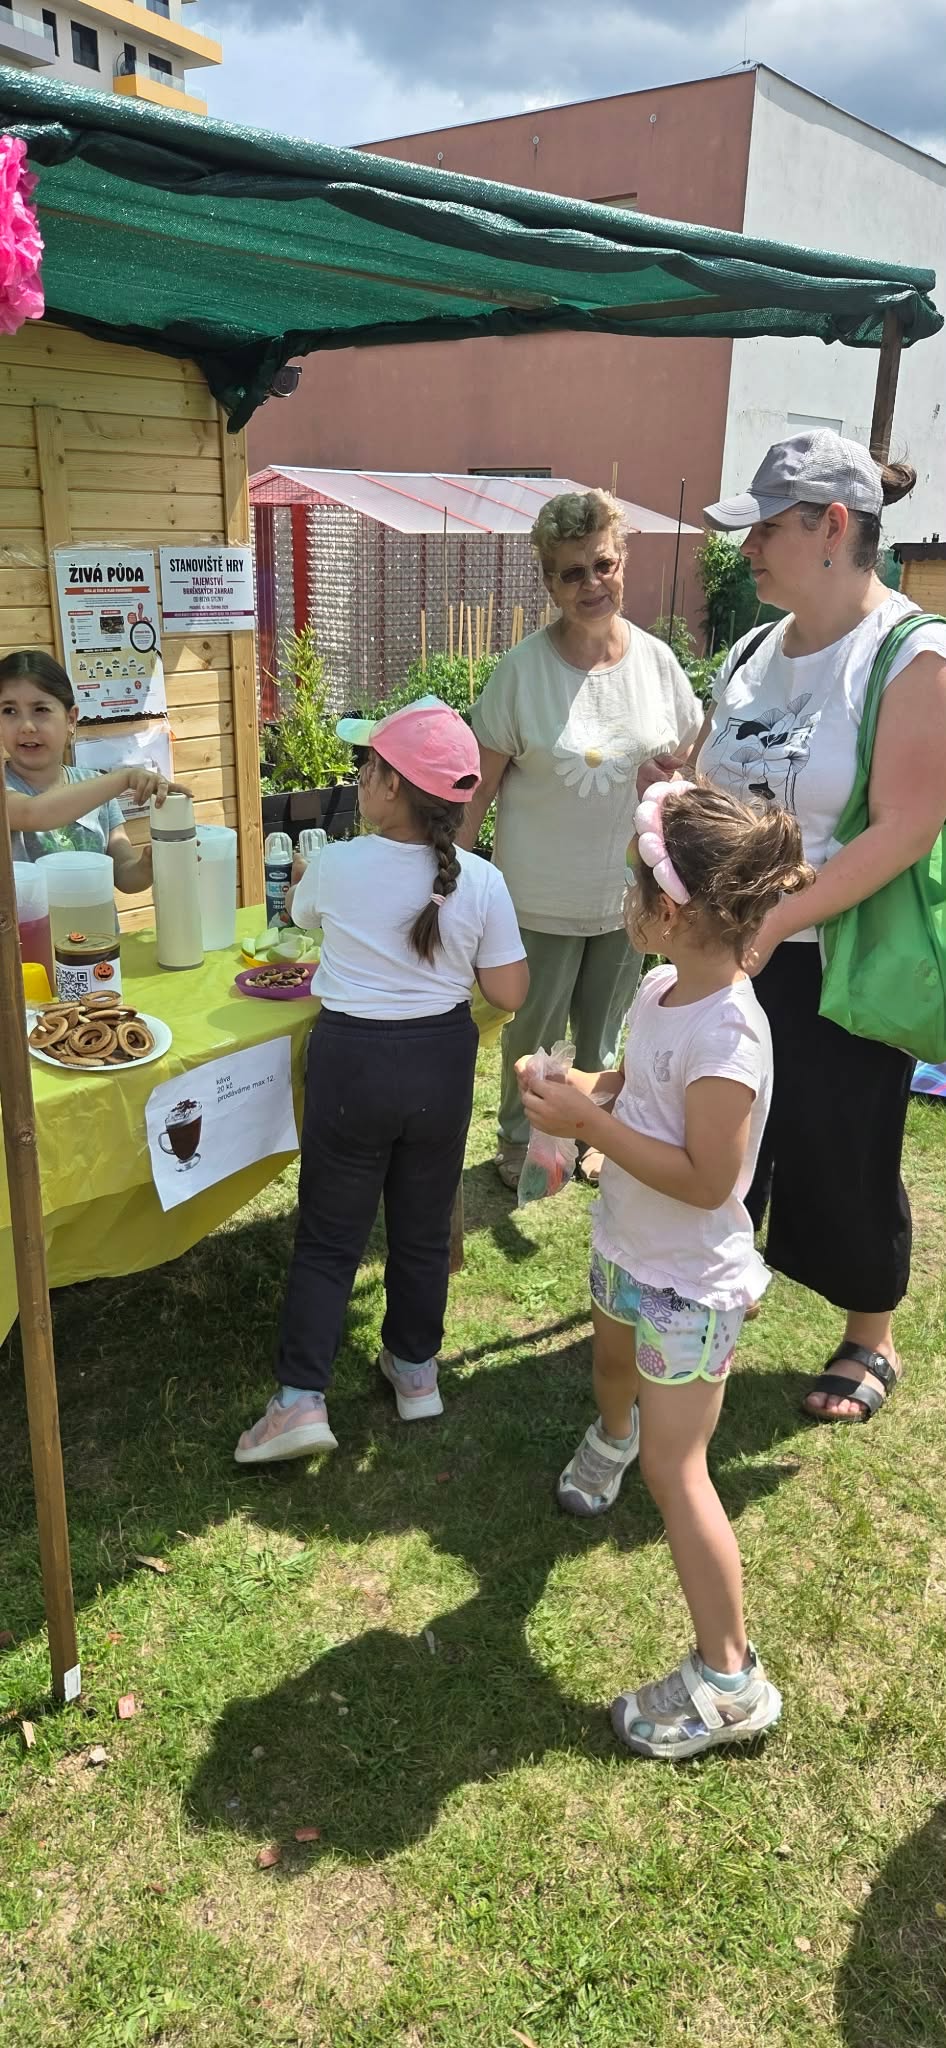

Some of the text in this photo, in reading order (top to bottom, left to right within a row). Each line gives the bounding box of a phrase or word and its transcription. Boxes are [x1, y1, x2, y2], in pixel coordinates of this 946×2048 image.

[170, 556, 244, 572] STANOVIŠTĚ HRY
[69, 563, 144, 582] ŽIVÁ PŮDA
[192, 575, 224, 586] TAJEMSTVÍ
[214, 587, 234, 595] ZAHRAD
[216, 1076, 230, 1084] káva
[217, 1085, 224, 1094] 20
[218, 1085, 250, 1103] prodáváme
[252, 1080, 265, 1088] max
